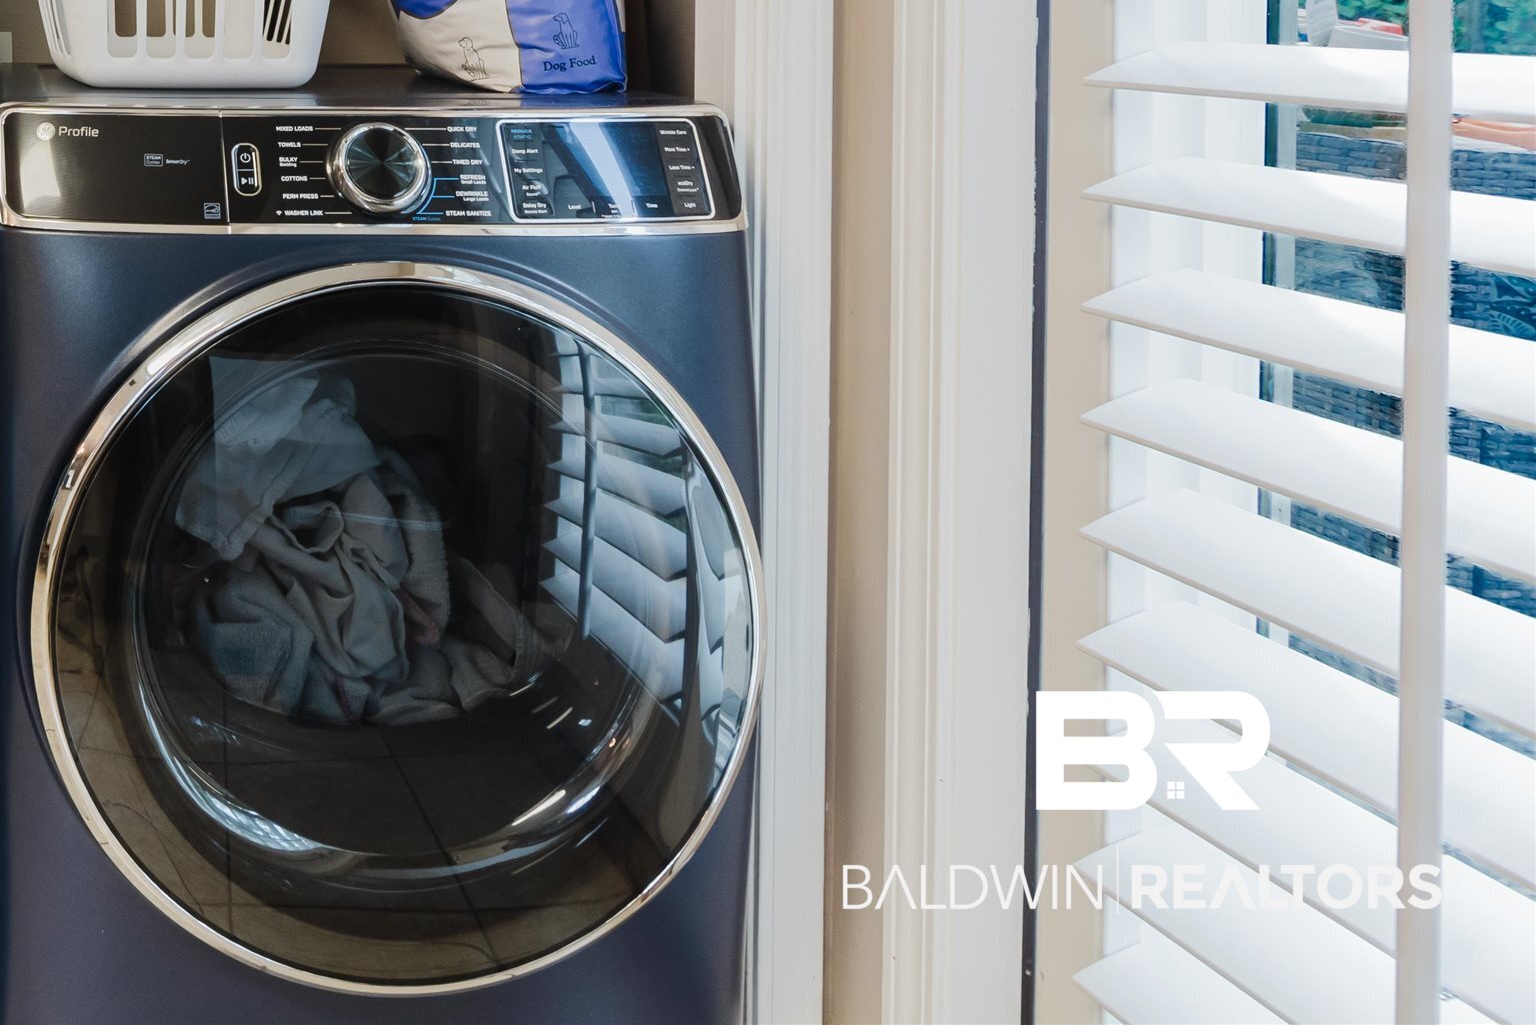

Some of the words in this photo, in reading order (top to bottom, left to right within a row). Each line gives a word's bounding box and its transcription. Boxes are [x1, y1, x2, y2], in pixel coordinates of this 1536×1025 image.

[542, 60, 568, 73] Dog
[568, 54, 598, 69] Food
[58, 126, 100, 137] Profile
